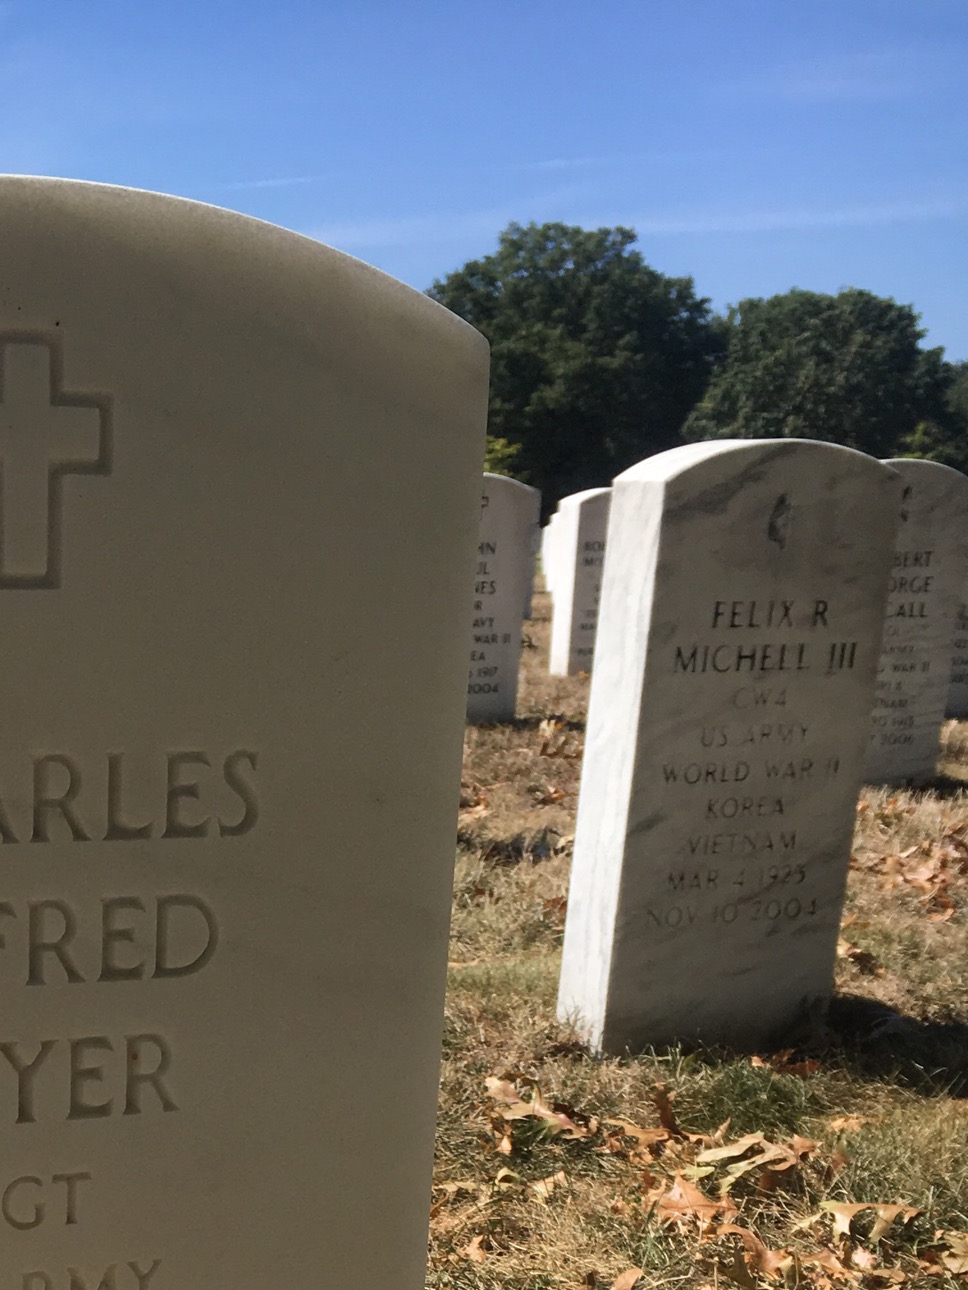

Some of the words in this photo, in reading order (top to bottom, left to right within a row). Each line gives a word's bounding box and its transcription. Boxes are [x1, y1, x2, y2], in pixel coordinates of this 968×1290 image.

[893, 551, 934, 568] BERT
[712, 600, 794, 629] FELIX
[811, 600, 828, 628] R
[673, 642, 810, 673] MICHELL
[826, 642, 857, 672] III
[733, 687, 787, 710] CW4
[700, 726, 728, 748] US
[742, 722, 811, 745] ARMY
[663, 761, 750, 784] WORLD
[766, 758, 814, 780] WAR
[705, 796, 785, 819] KOREA
[688, 830, 797, 855] VIETNAM
[668, 869, 719, 891] MAR
[647, 904, 697, 927] NOV
